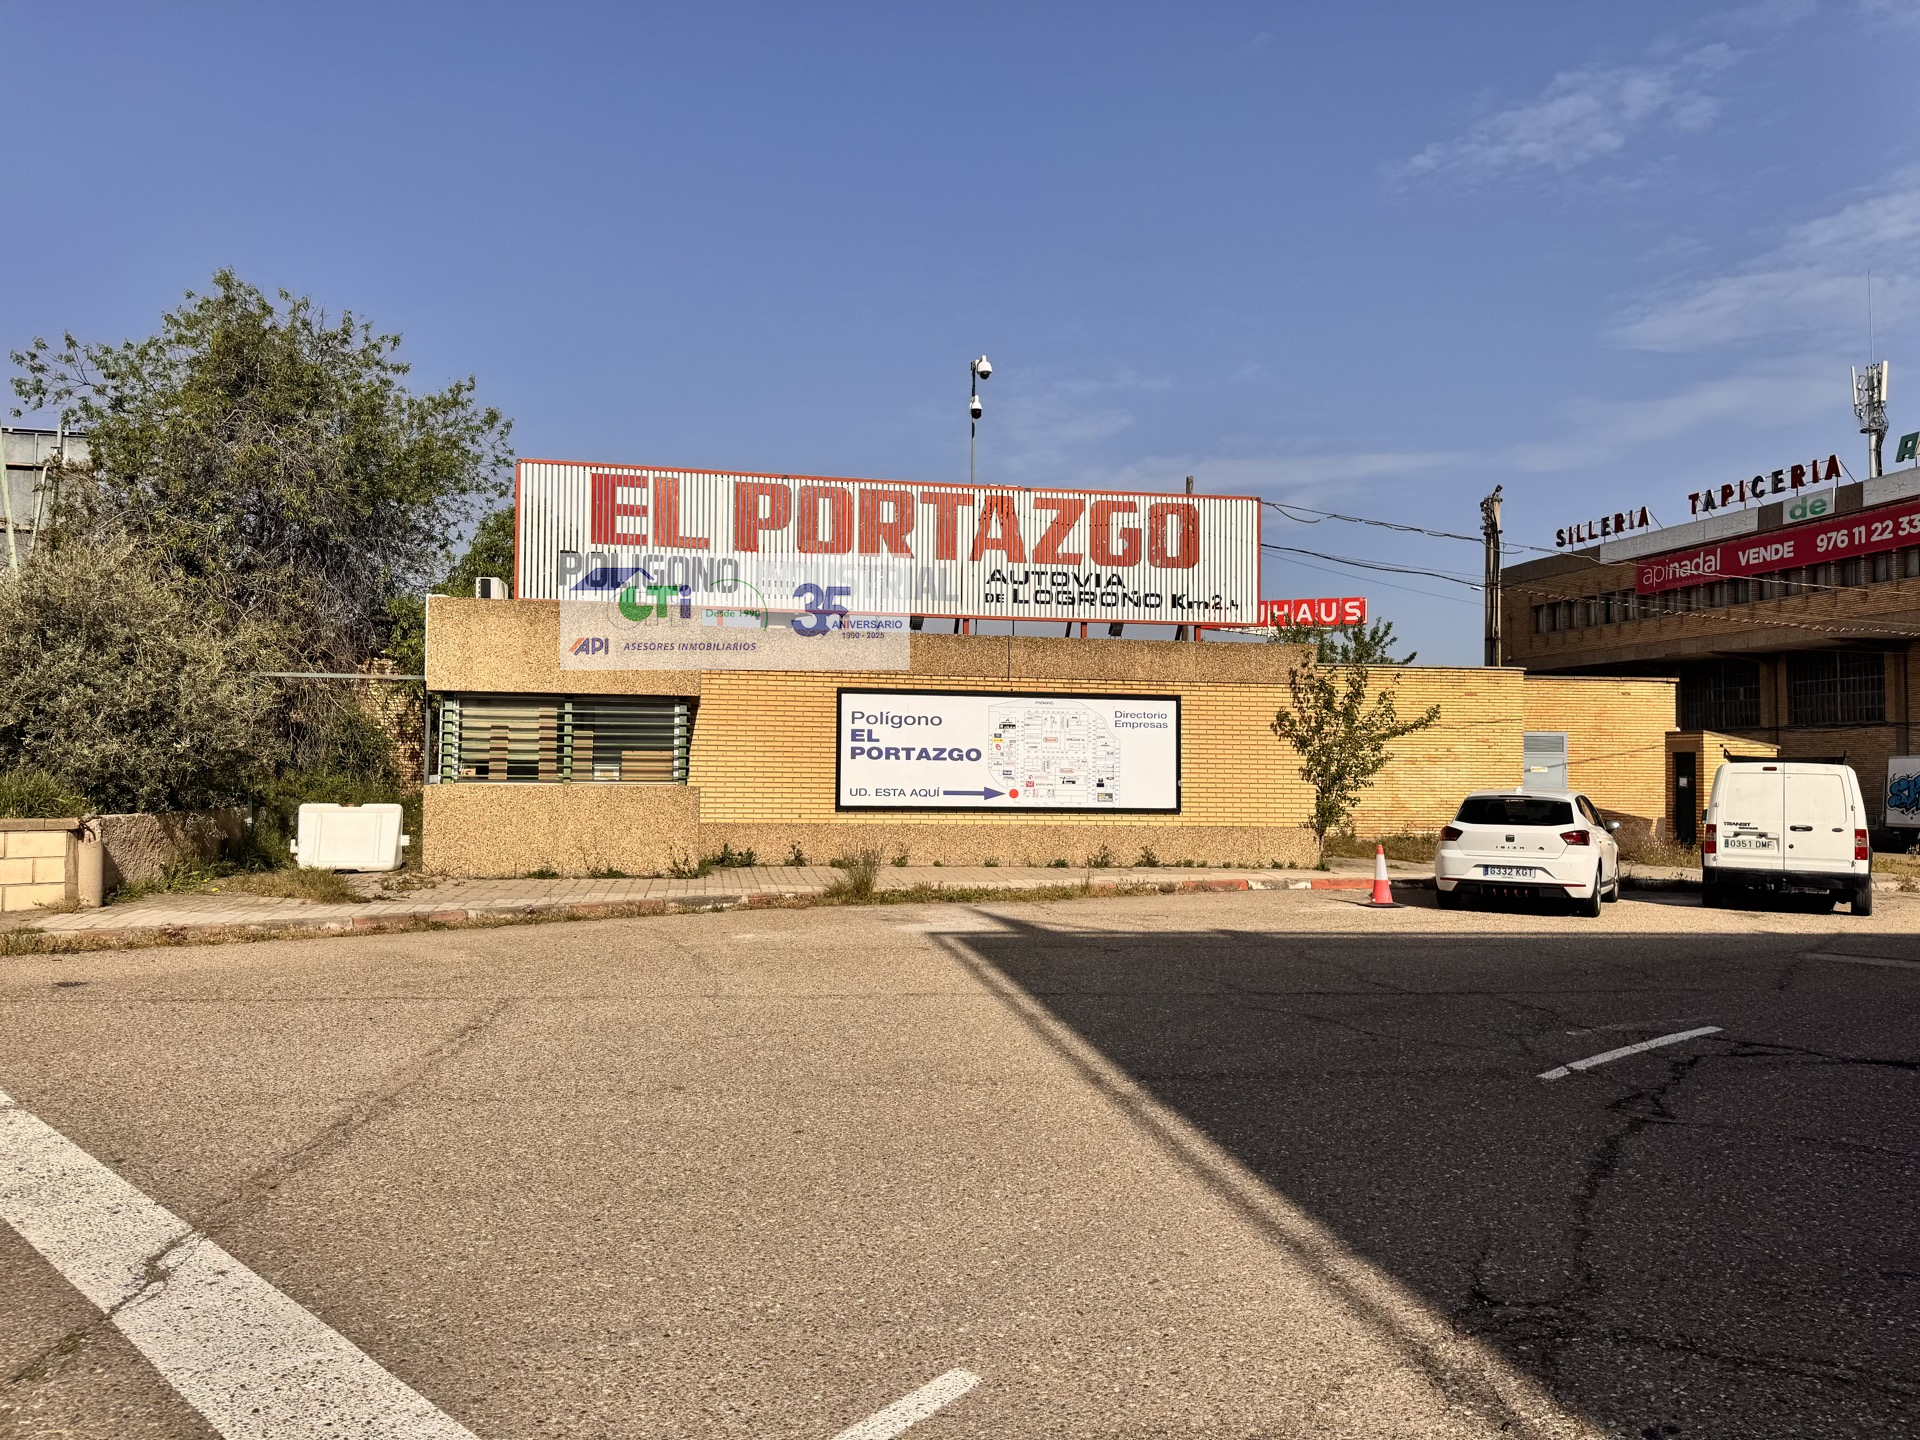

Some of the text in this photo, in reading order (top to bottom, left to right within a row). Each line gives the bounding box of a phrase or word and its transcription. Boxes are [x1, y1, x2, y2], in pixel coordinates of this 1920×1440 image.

[1688, 454, 1843, 515] TAPICERIA
[1789, 497, 1827, 520] de
[590, 473, 1199, 569] EL PORTAZGO
[1556, 506, 1651, 547] SILLERIA
[1643, 513, 1920, 587] apinadal VENDE 976 11 22 33
[559, 550, 739, 593] POLIGONO
[986, 568, 1126, 589] AUTOVIA
[984, 593, 1005, 604] DE
[1013, 588, 1163, 609] LOGROÑO
[851, 711, 943, 728] Polígono
[1114, 710, 1168, 720] Directorio
[1114, 720, 1169, 730] Empresas
[850, 729, 880, 742] EL
[850, 746, 982, 762] PORTAZGO
[849, 786, 940, 798] UD. ESTA AQUÍ
[1730, 839, 1773, 849] 0351 DMF
[1490, 867, 1534, 877] 6332 KGT
